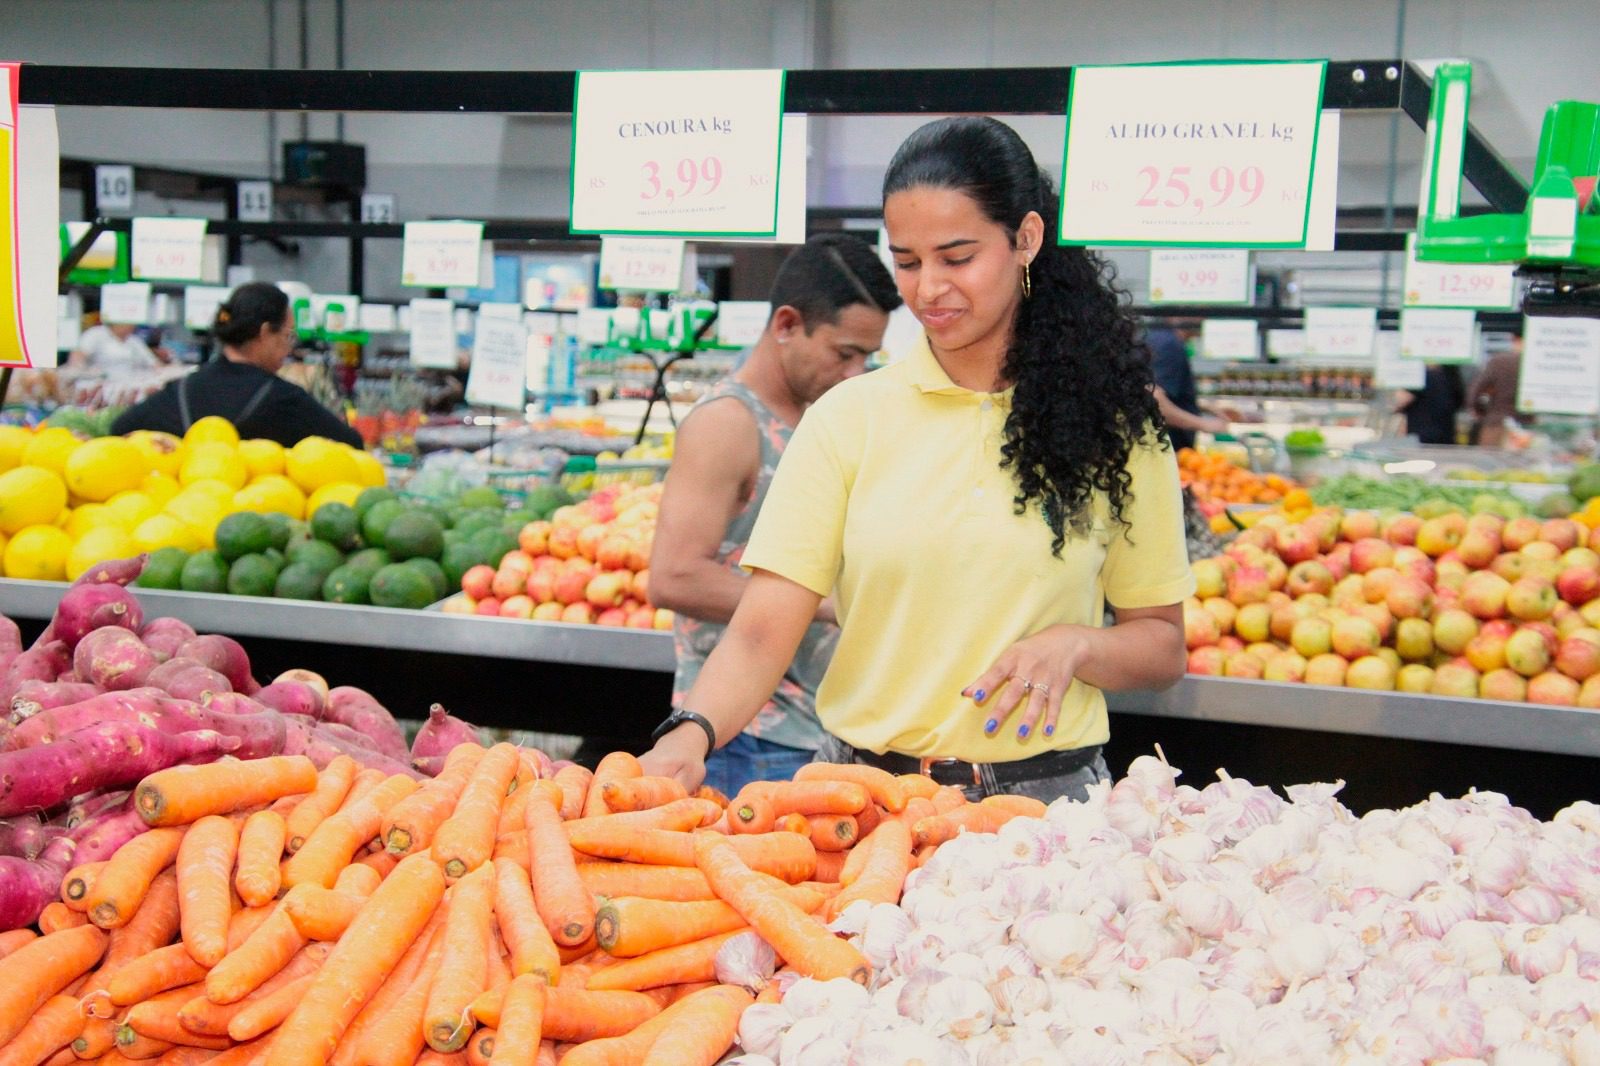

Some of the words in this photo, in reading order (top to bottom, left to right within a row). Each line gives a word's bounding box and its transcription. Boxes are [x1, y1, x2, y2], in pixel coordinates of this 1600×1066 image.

[617, 117, 707, 139] CENOURA
[712, 115, 732, 135] kg
[1105, 122, 1168, 140] ALHO
[1172, 122, 1265, 140] GRANEL
[1271, 122, 1294, 142] kg
[101, 175, 128, 197] 10
[639, 156, 723, 206] 3,99
[1135, 165, 1265, 217] 25,99
[244, 192, 266, 211] 11
[1178, 270, 1219, 287] 9,99
[1439, 273, 1496, 294] 12,99
